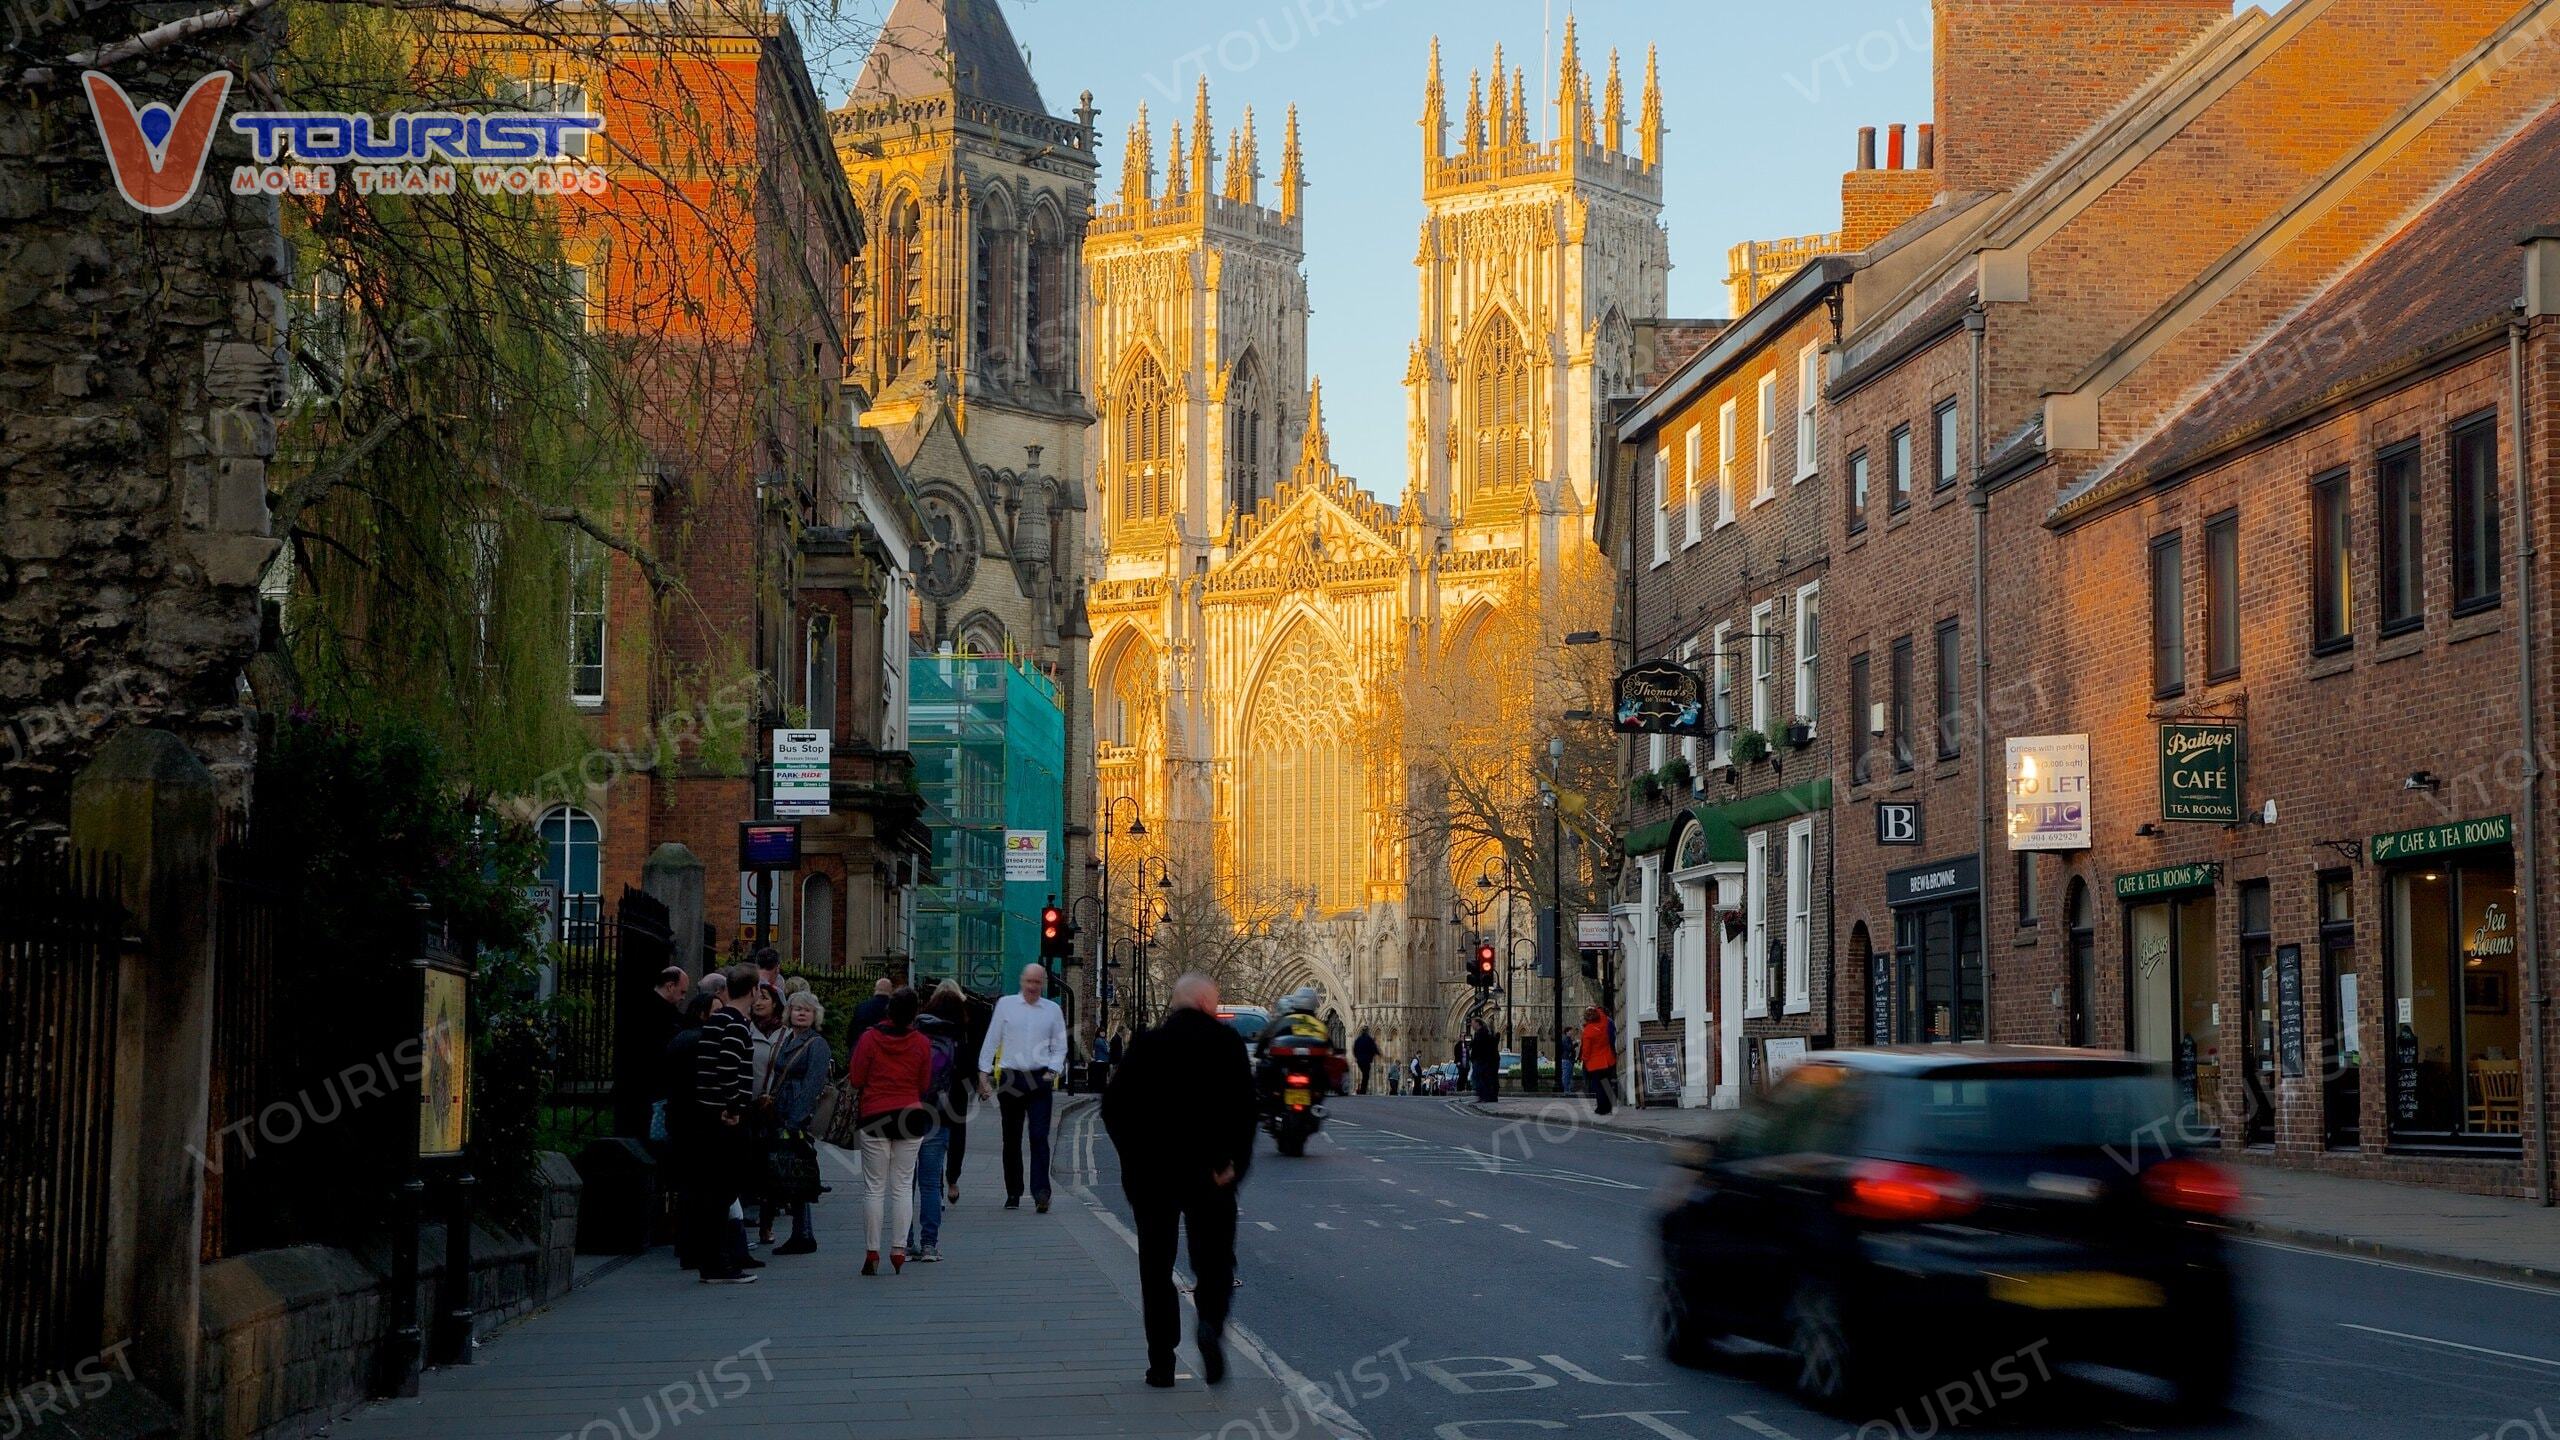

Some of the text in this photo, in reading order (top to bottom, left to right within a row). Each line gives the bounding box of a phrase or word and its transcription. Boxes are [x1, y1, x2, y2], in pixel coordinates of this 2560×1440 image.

[1635, 681, 1687, 697] Thomas's
[779, 744, 824, 754] Bus Stop
[2010, 742, 2085, 753] Offices with parking
[2167, 731, 2232, 756] Baileys
[2012, 776, 2085, 795] TO LET
[2172, 766, 2227, 789] CAFÉ
[2171, 805, 2232, 815] TEA ROOMS
[1884, 807, 1913, 839] B
[2400, 832, 2424, 853] CAFE
[2428, 830, 2437, 849] &
[2440, 827, 2461, 847] TEA
[2465, 818, 2505, 844] ROOMS
[2118, 876, 2136, 894] CAFE
[2138, 875, 2145, 891] &
[2147, 873, 2160, 889] TEA
[2163, 868, 2191, 887] ROOMS
[2483, 903, 2507, 932] Tea
[2470, 928, 2514, 957] Rooms
